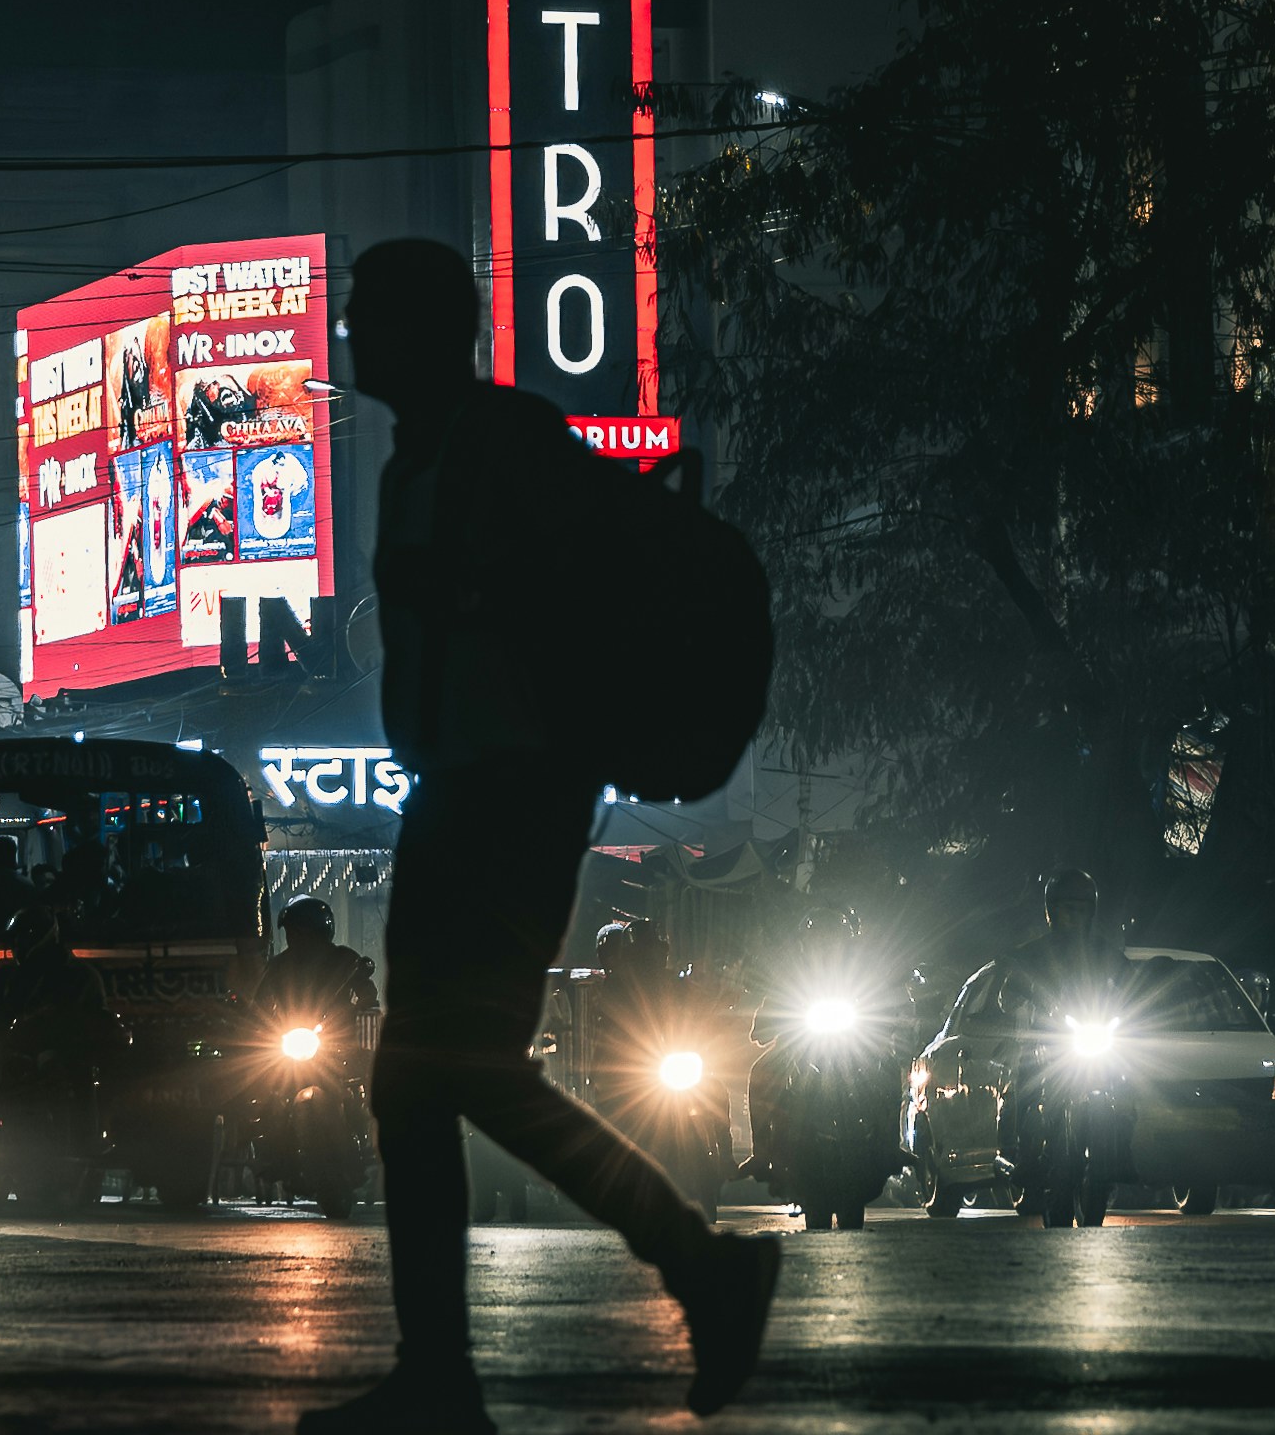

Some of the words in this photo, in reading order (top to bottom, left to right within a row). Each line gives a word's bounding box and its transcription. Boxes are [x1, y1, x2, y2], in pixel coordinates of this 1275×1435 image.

[222, 256, 310, 291] WATCH
[207, 289, 278, 321] WEEK
[280, 286, 310, 314] AT
[225, 329, 296, 357] INOX
[57, 390, 89, 440] WEEK
[89, 386, 102, 430] AT
